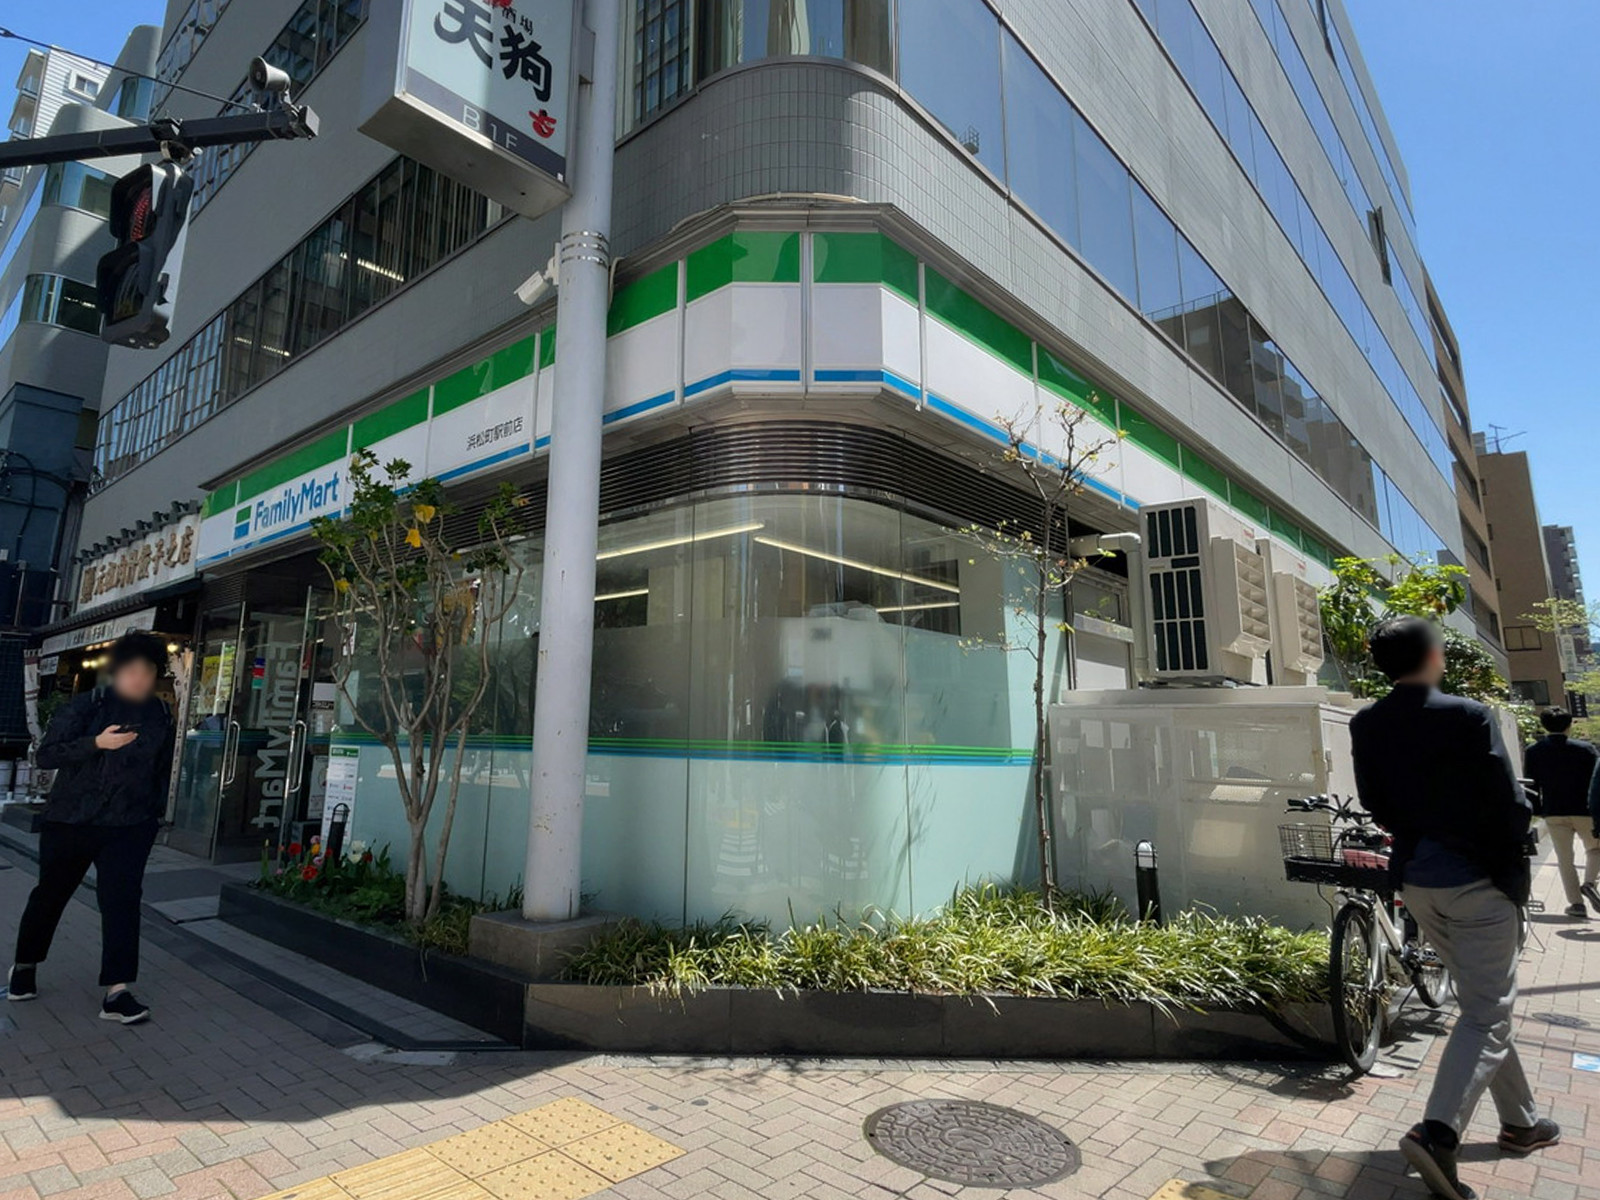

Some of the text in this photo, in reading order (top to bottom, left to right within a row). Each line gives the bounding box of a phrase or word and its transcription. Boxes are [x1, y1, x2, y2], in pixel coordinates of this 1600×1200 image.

[433, 0, 553, 103] 天狗
[462, 103, 518, 149] B1F
[465, 416, 524, 451] 浜松町駅前店
[253, 471, 341, 532] FamilyMart
